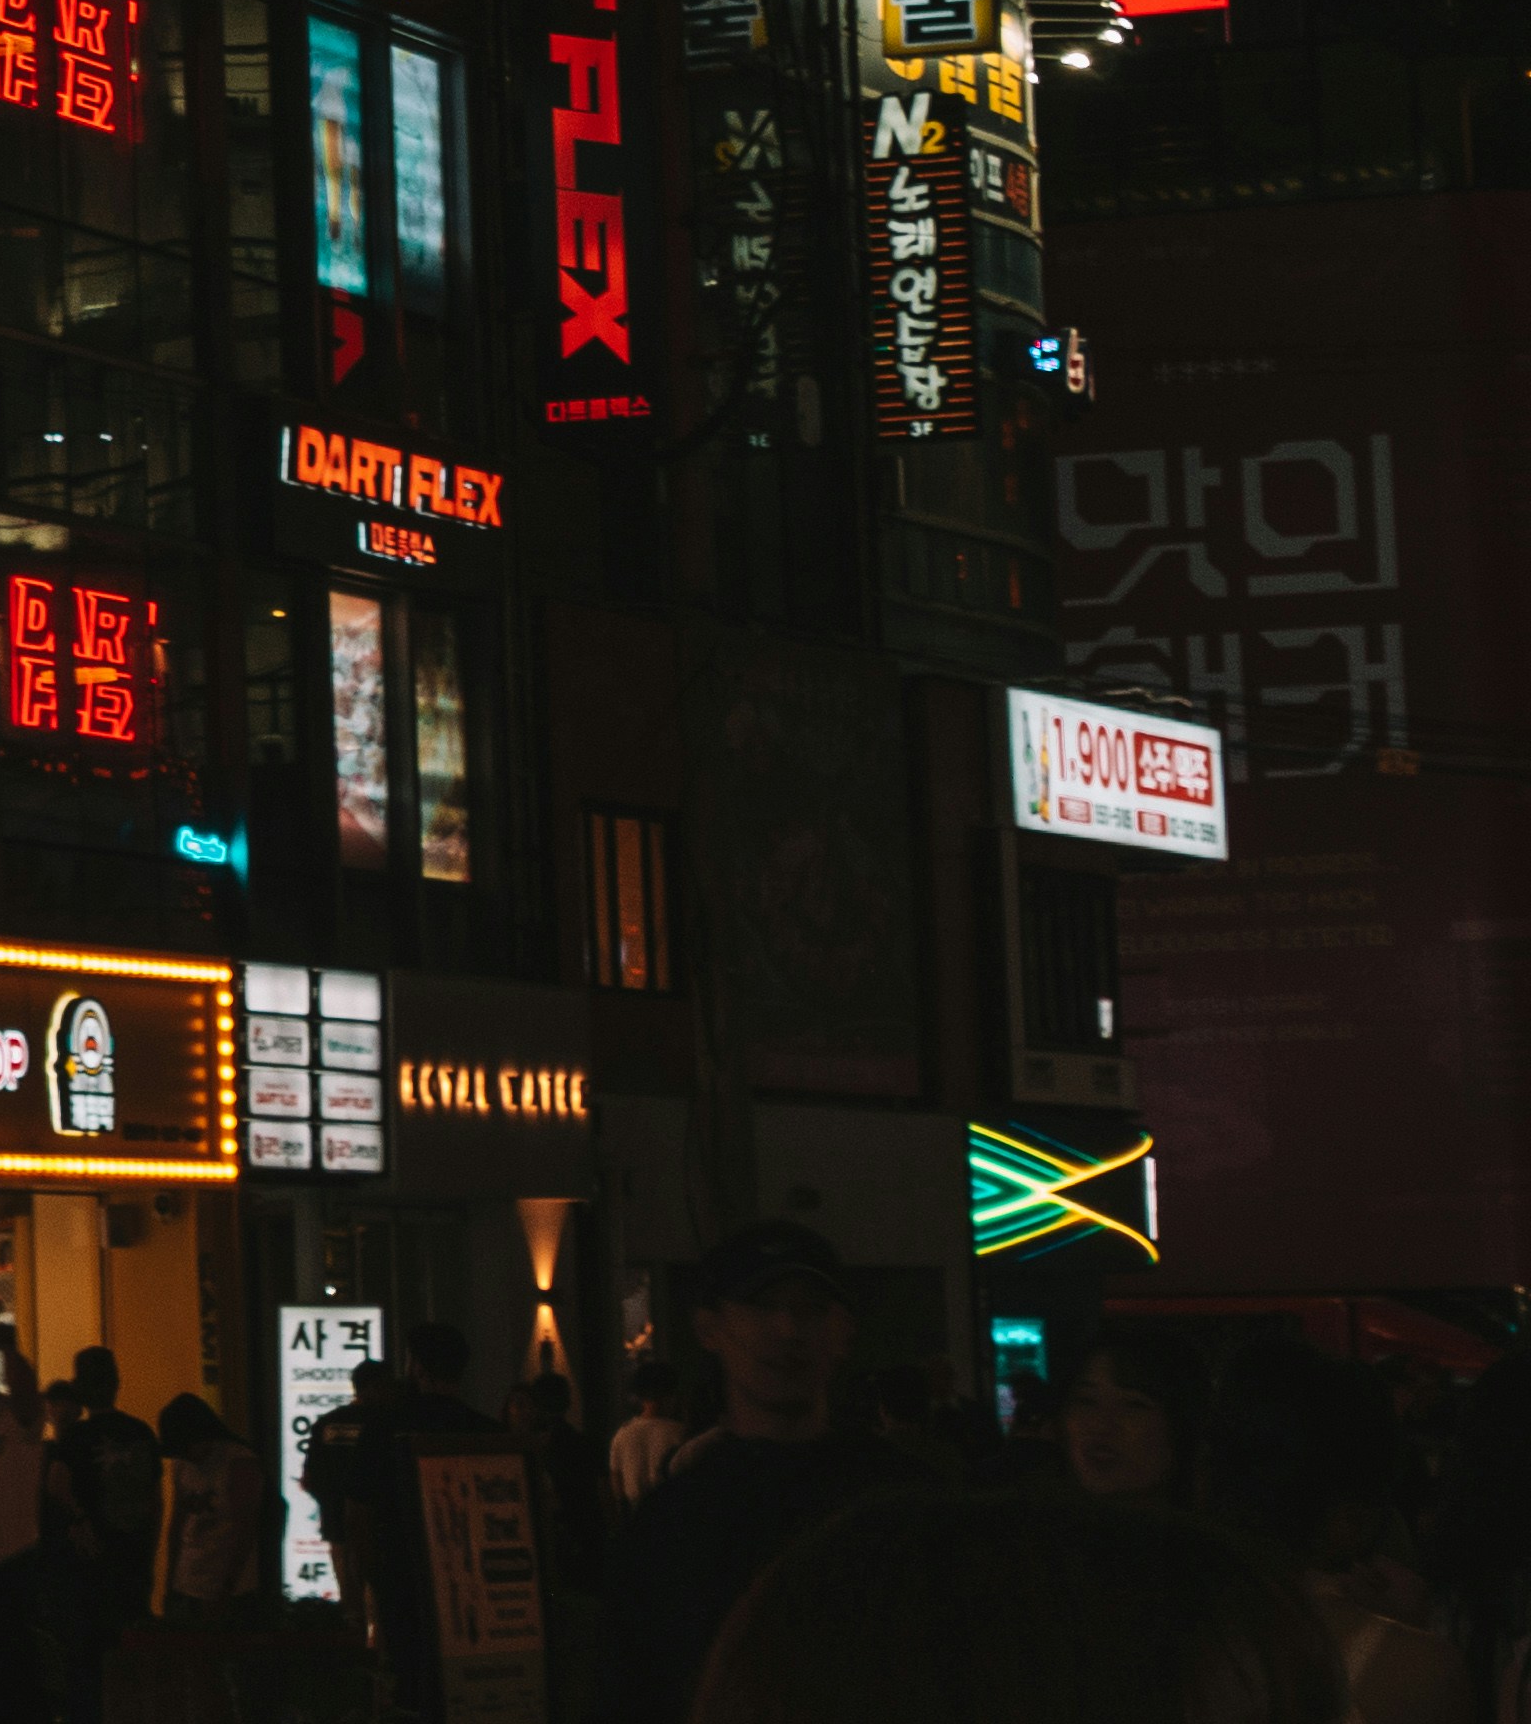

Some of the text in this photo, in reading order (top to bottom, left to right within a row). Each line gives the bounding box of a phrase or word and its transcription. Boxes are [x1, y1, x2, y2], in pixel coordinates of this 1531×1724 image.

[549, 33, 631, 365] FLEX
[296, 424, 402, 507] DART
[908, 420, 934, 438] 3F
[409, 452, 503, 528] FLEX
[297, 1563, 329, 1583] 4F
